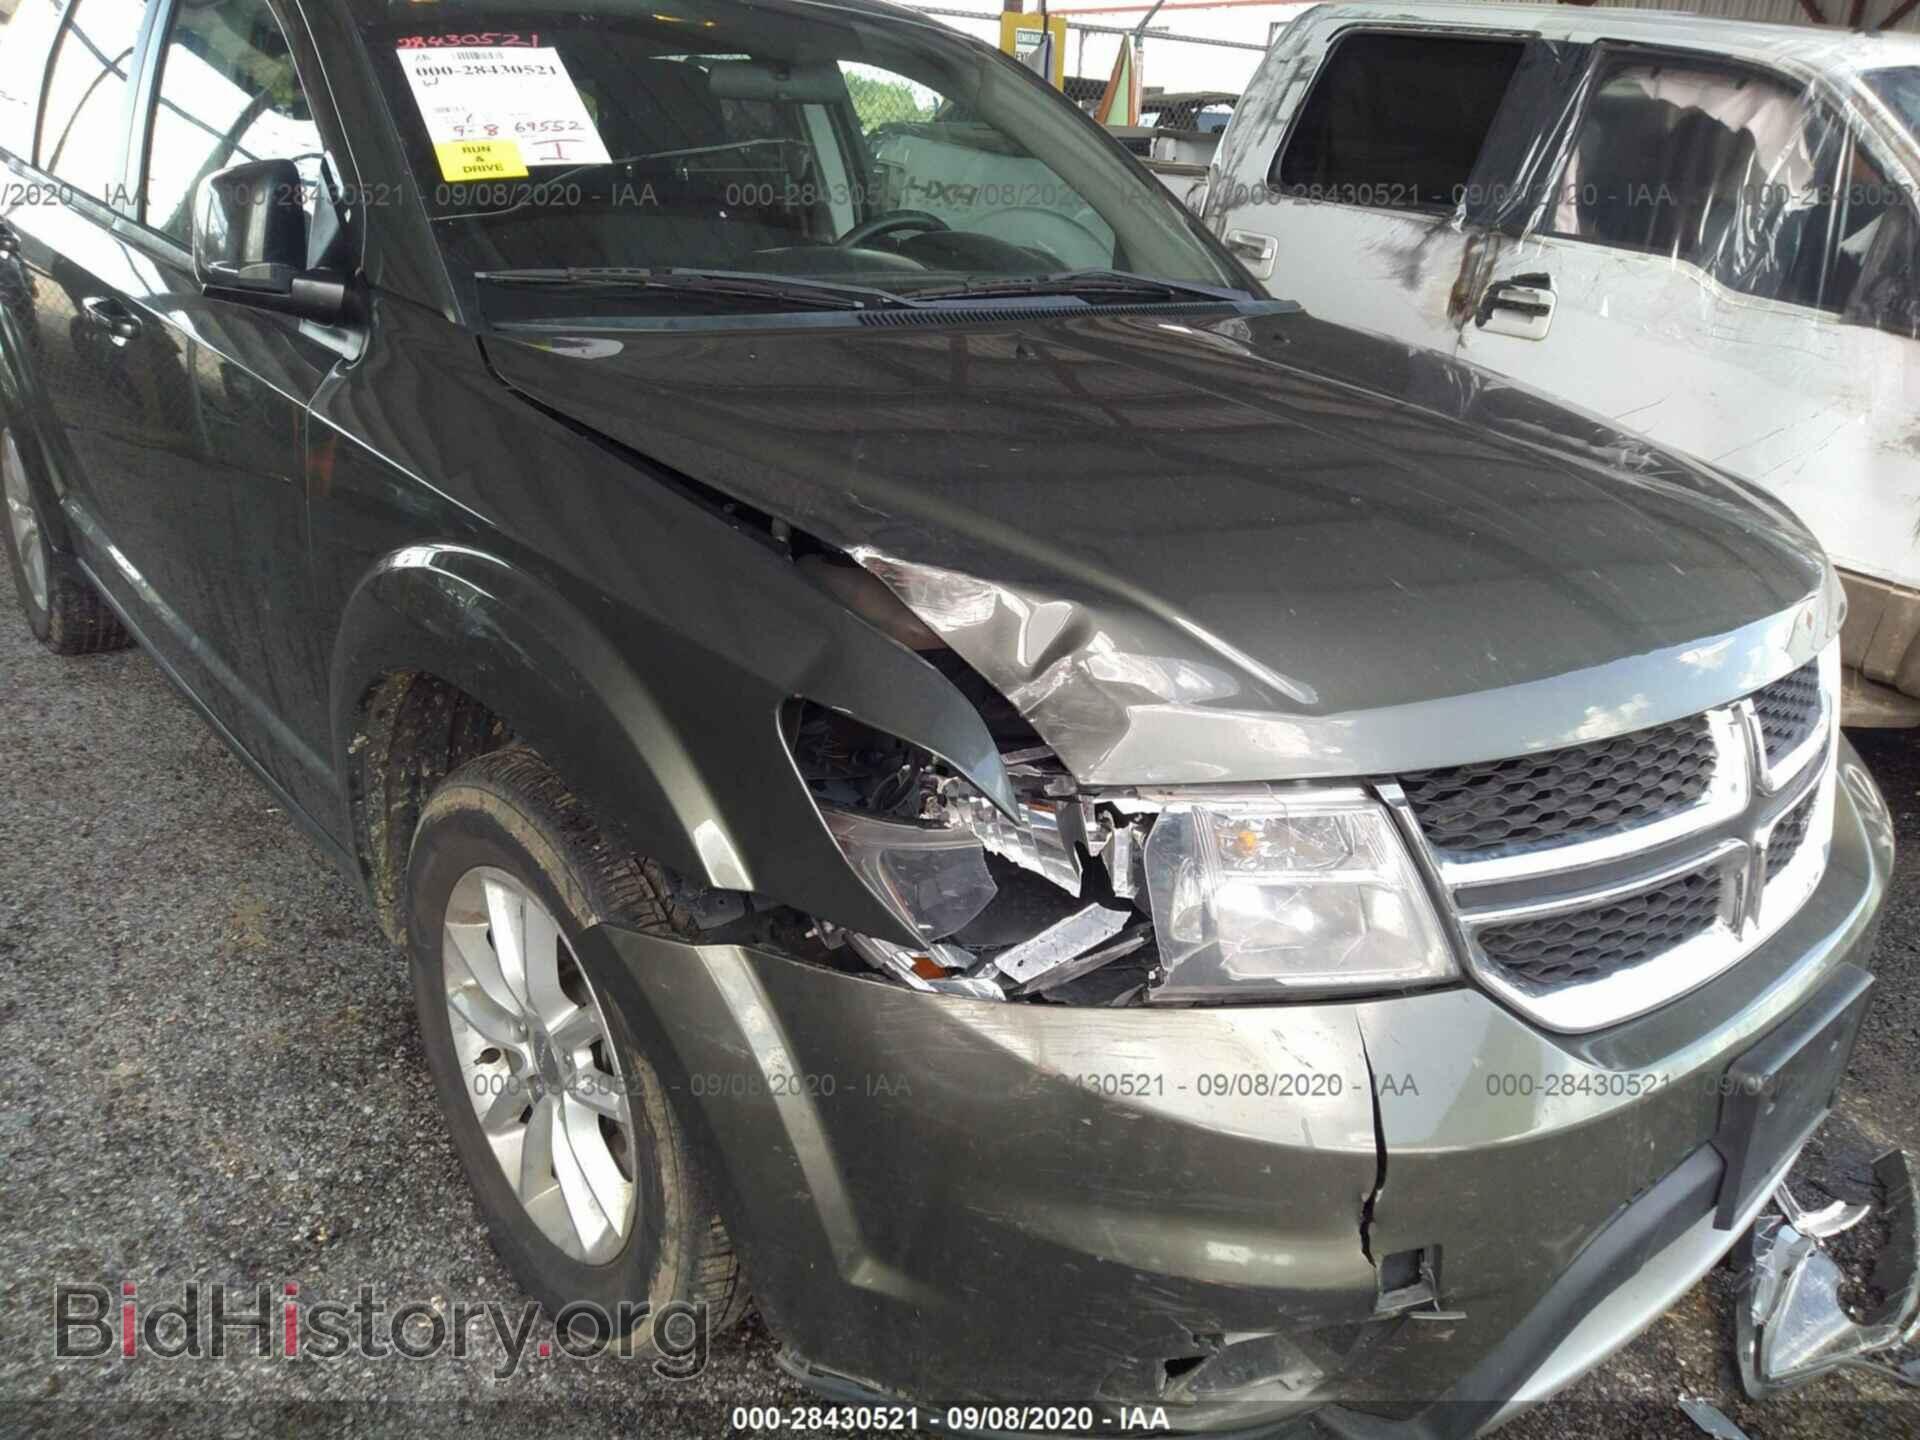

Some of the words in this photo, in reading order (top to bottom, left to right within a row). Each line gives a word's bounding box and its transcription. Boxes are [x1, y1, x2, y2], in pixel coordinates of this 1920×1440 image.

[416, 64, 556, 76] 000-28430521
[462, 146, 491, 154] RUN
[463, 163, 504, 174] DRIVE
